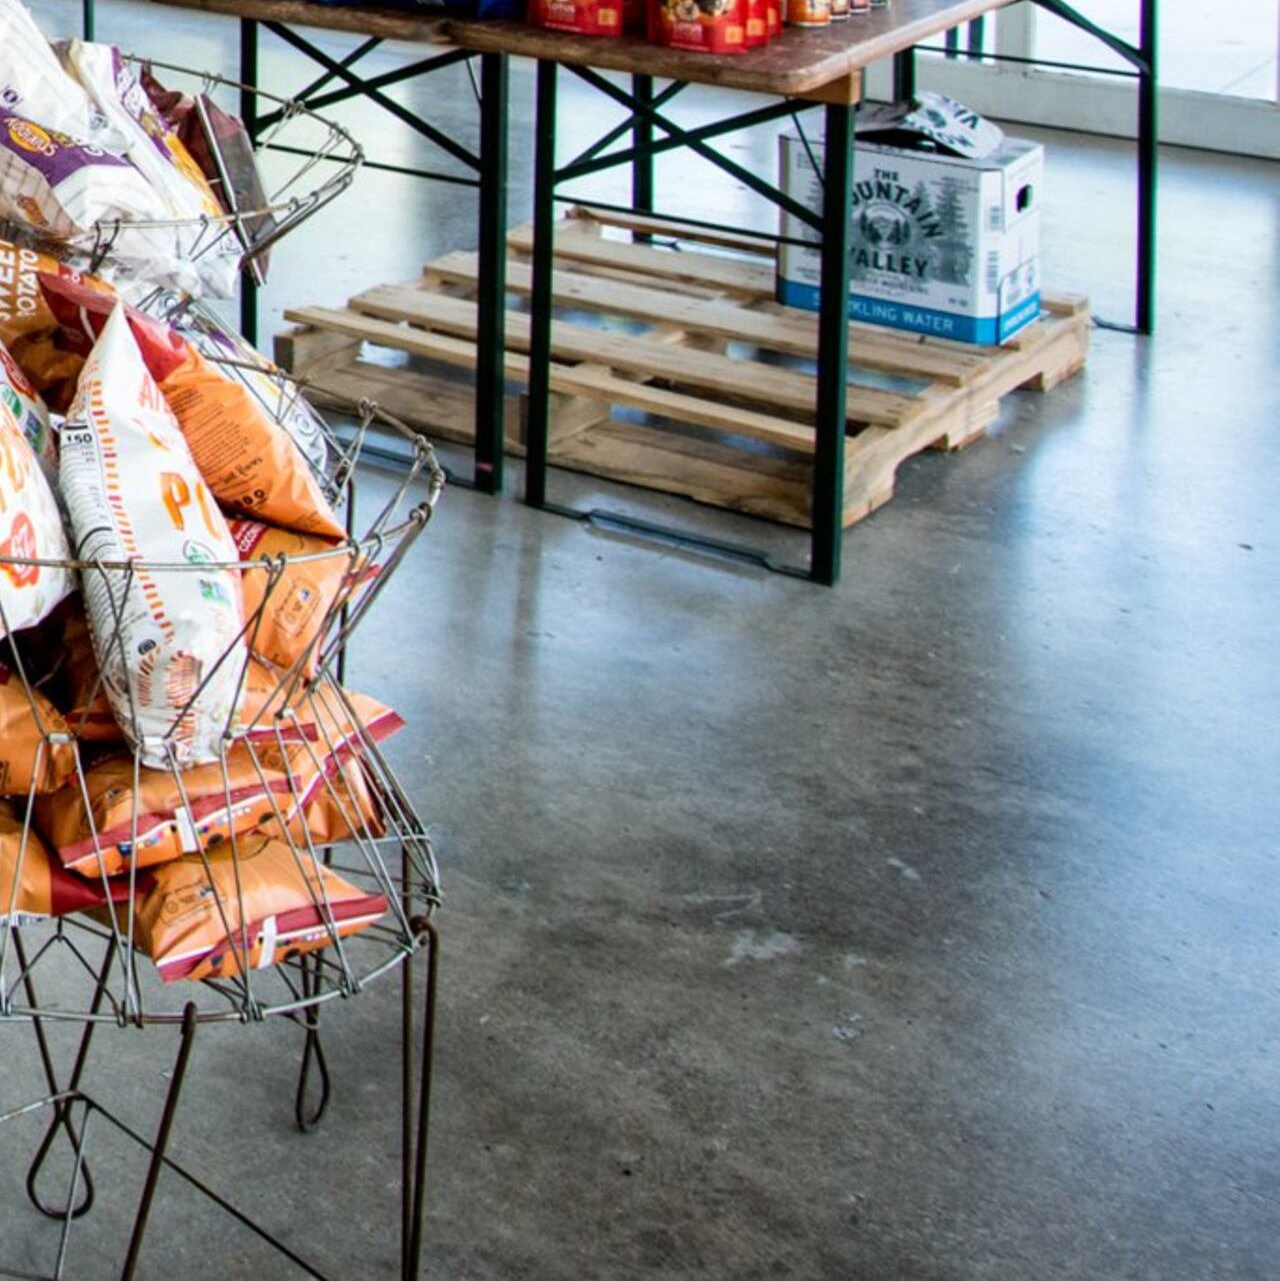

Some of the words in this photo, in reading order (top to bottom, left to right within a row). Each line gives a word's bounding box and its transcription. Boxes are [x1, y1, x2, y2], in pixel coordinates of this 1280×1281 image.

[873, 168, 900, 183] THE
[850, 248, 929, 279] ALLEY
[901, 310, 954, 333] WATER
[66, 432, 93, 445] 150
